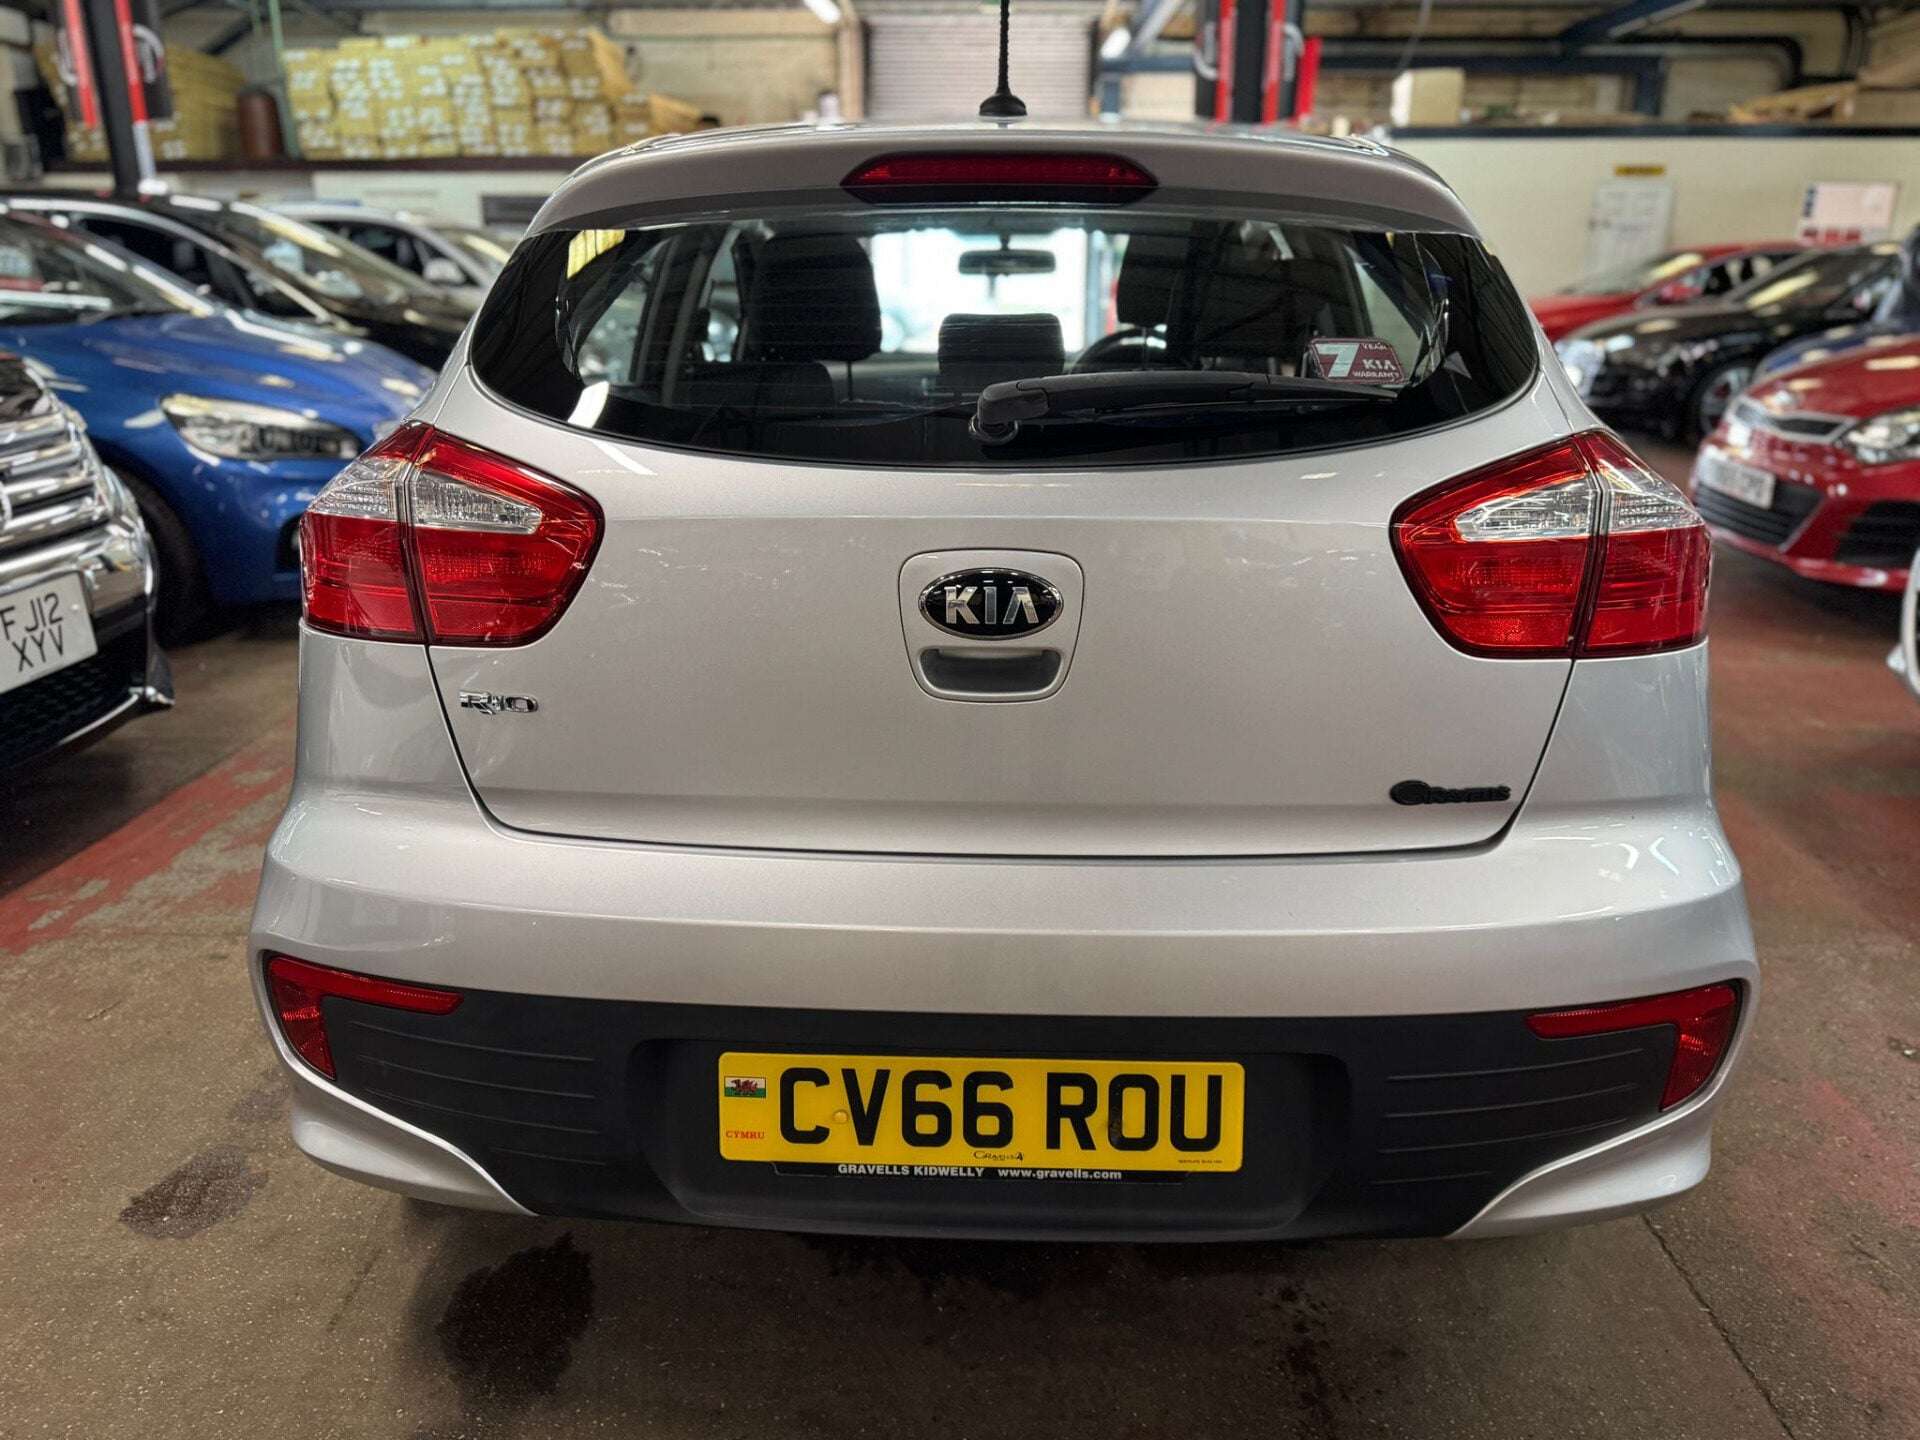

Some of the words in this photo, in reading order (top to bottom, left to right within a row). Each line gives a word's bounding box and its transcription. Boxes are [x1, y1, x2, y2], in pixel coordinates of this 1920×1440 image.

[1315, 343, 1360, 378] 7
[1362, 358, 1397, 371] KIA
[944, 586, 1040, 625] KIA
[12, 624, 63, 673] XYV
[780, 1067, 1014, 1149] CV66
[1046, 1072, 1223, 1152] ROU
[726, 1130, 765, 1139] CYMRU
[838, 1164, 909, 1176] GRAVELLS
[914, 1166, 984, 1177] KIDWELLY
[998, 1168, 1122, 1180] www.gravells.com
